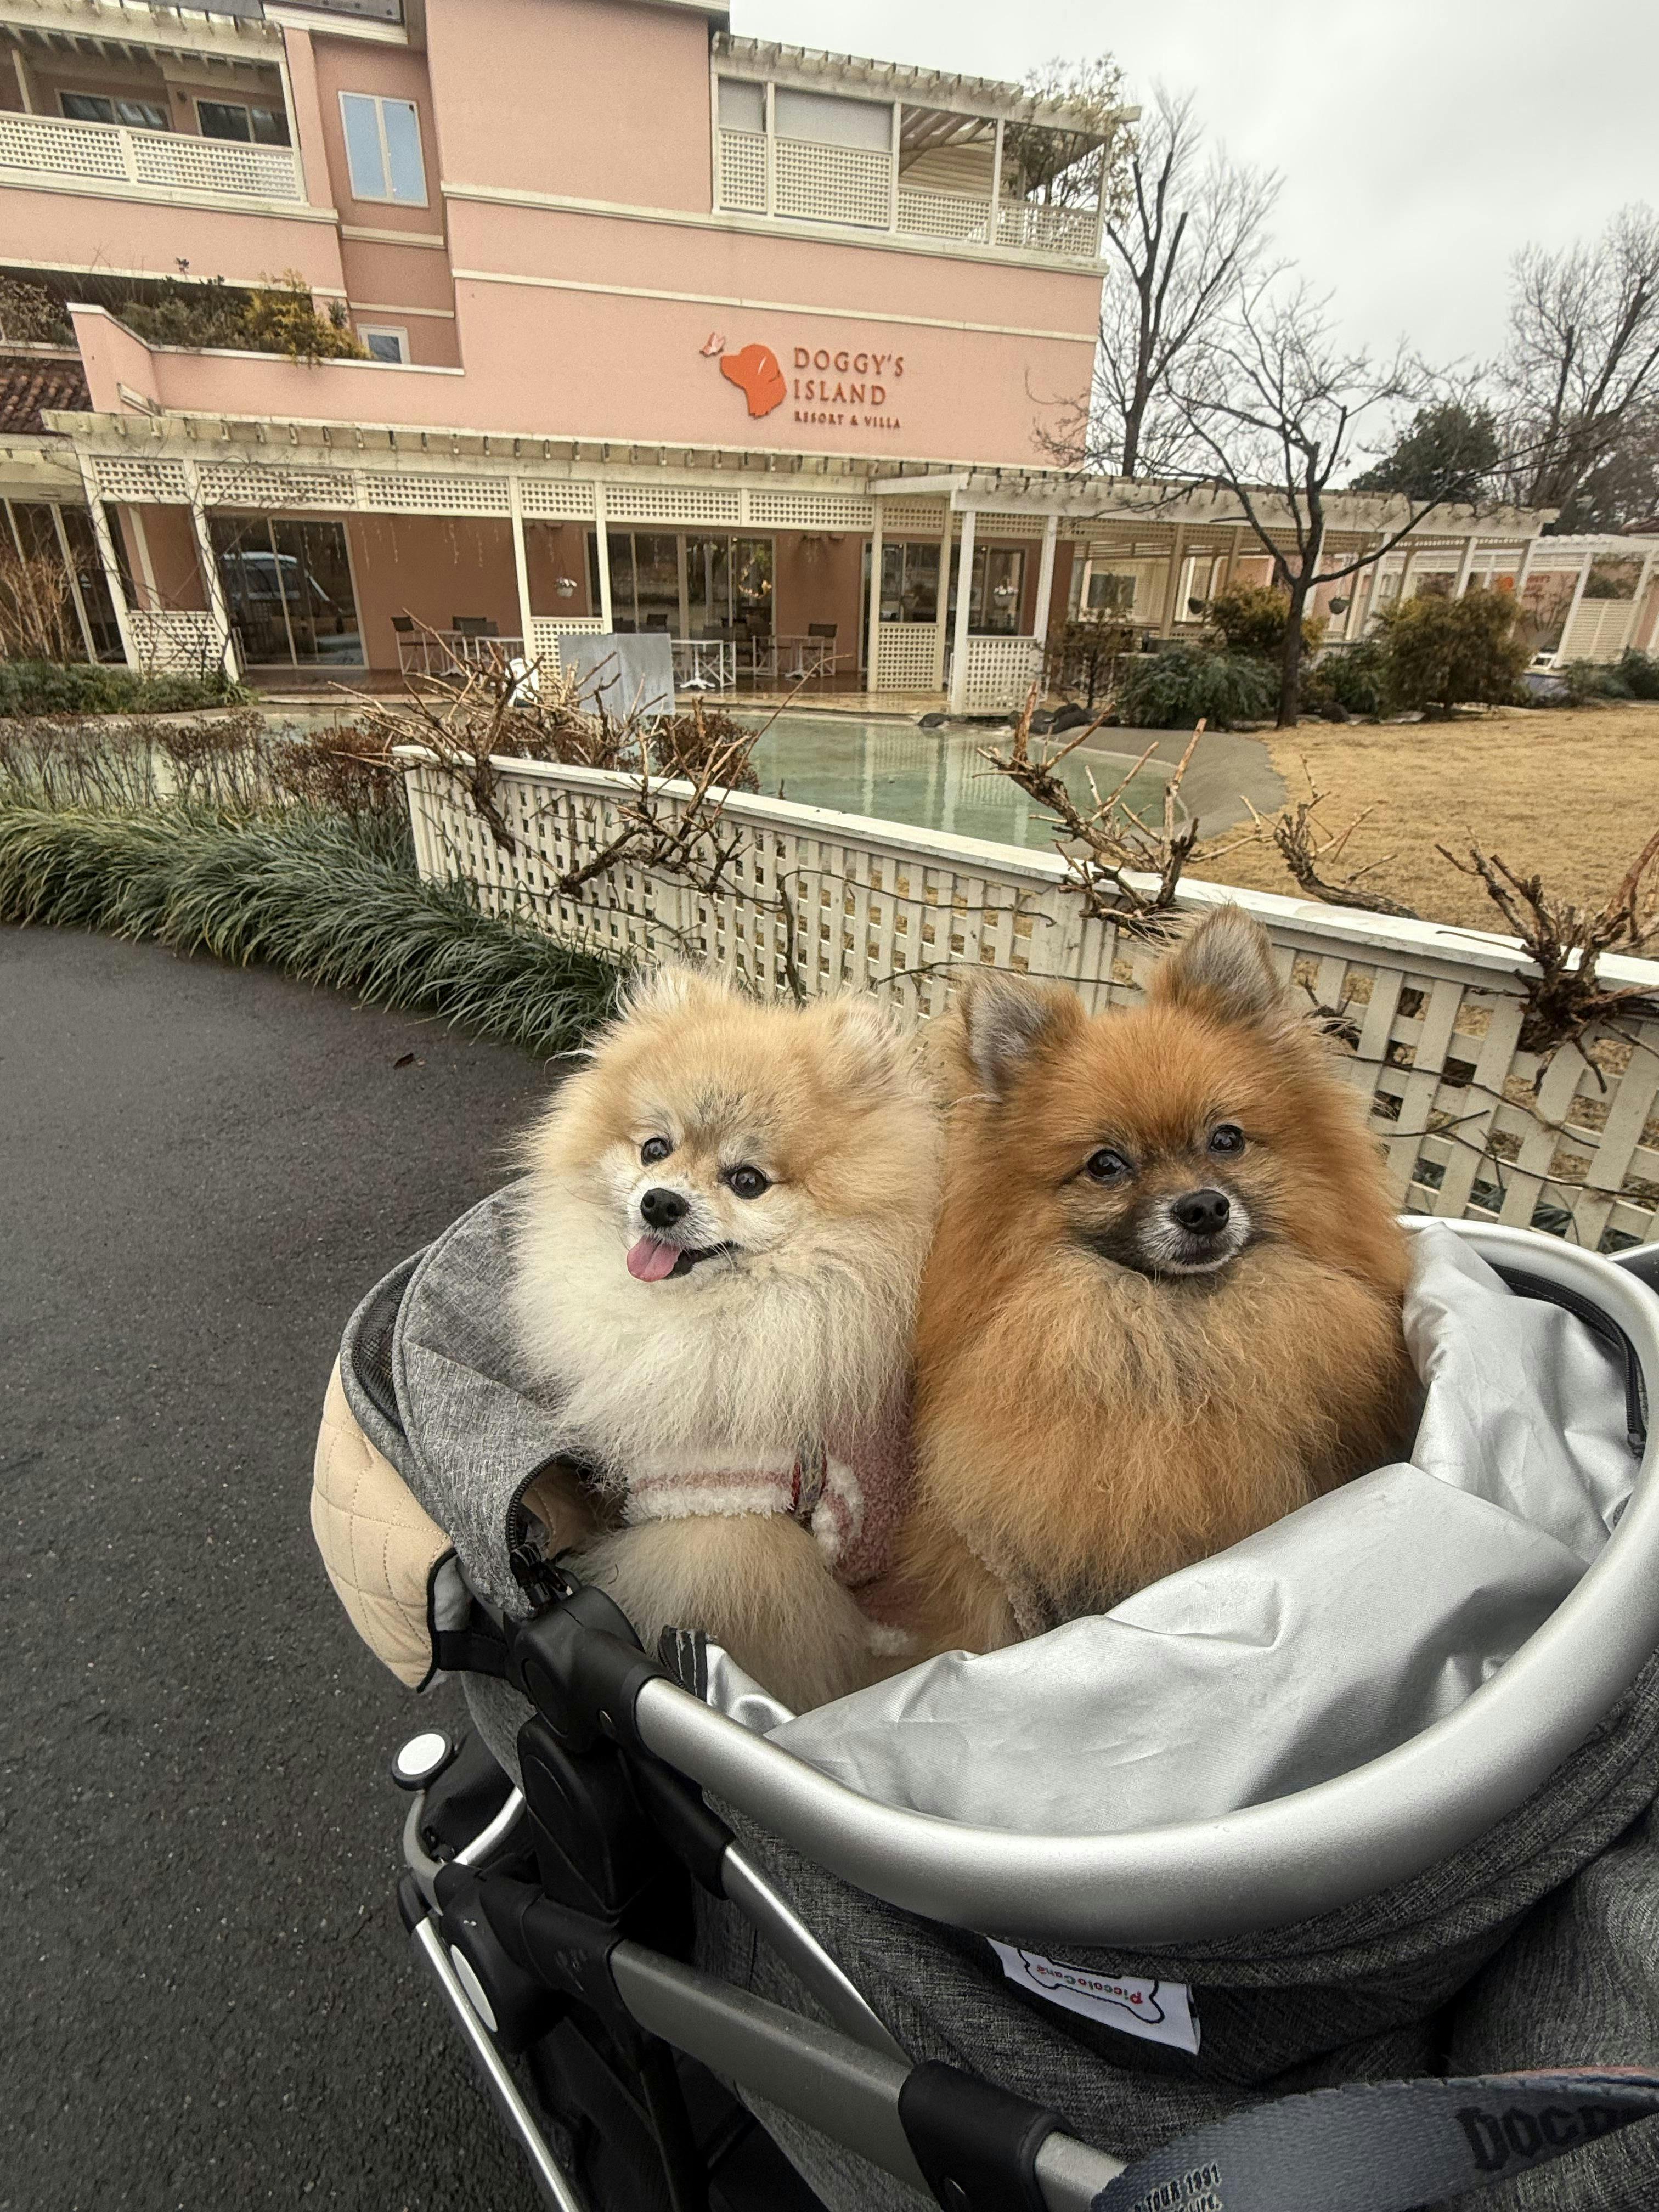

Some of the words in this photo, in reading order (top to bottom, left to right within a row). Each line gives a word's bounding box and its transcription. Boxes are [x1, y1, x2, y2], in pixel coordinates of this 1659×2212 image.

[794, 347, 904, 377] DOGGY'S
[794, 379, 887, 405] ISLAND
[794, 411, 844, 425] RESORT
[850, 415, 859, 426] &
[864, 416, 900, 428] VILLA
